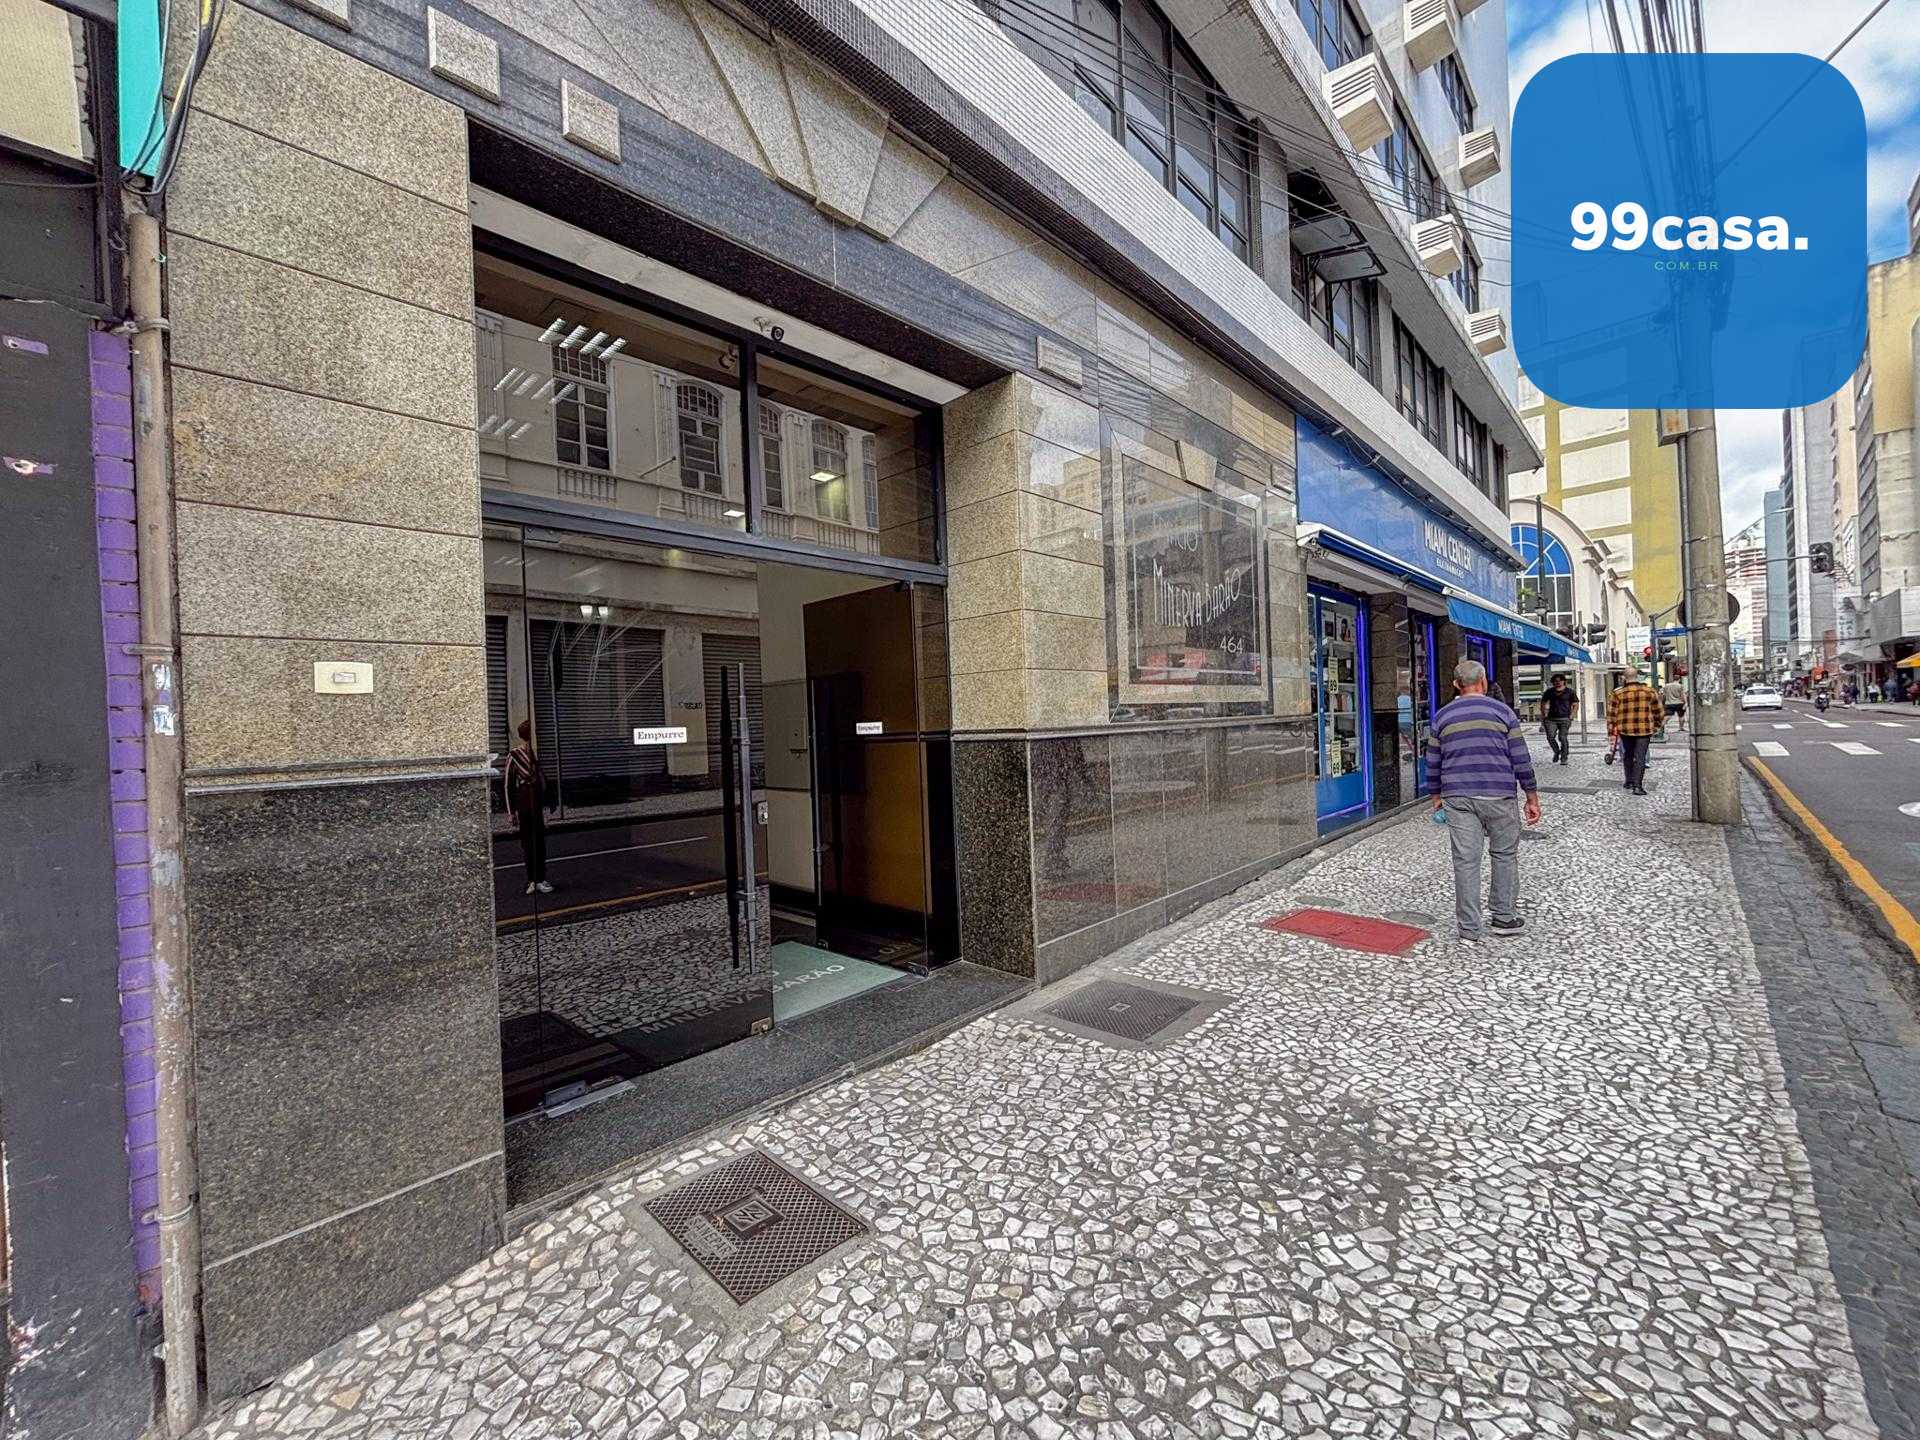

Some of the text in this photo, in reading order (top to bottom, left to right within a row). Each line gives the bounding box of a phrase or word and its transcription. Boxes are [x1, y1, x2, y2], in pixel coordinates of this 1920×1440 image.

[1448, 536, 1472, 571] CENTER
[1152, 559, 1242, 627] MINERVA BARÃO
[1220, 636, 1244, 655] 464
[638, 731, 684, 742] Empurre
